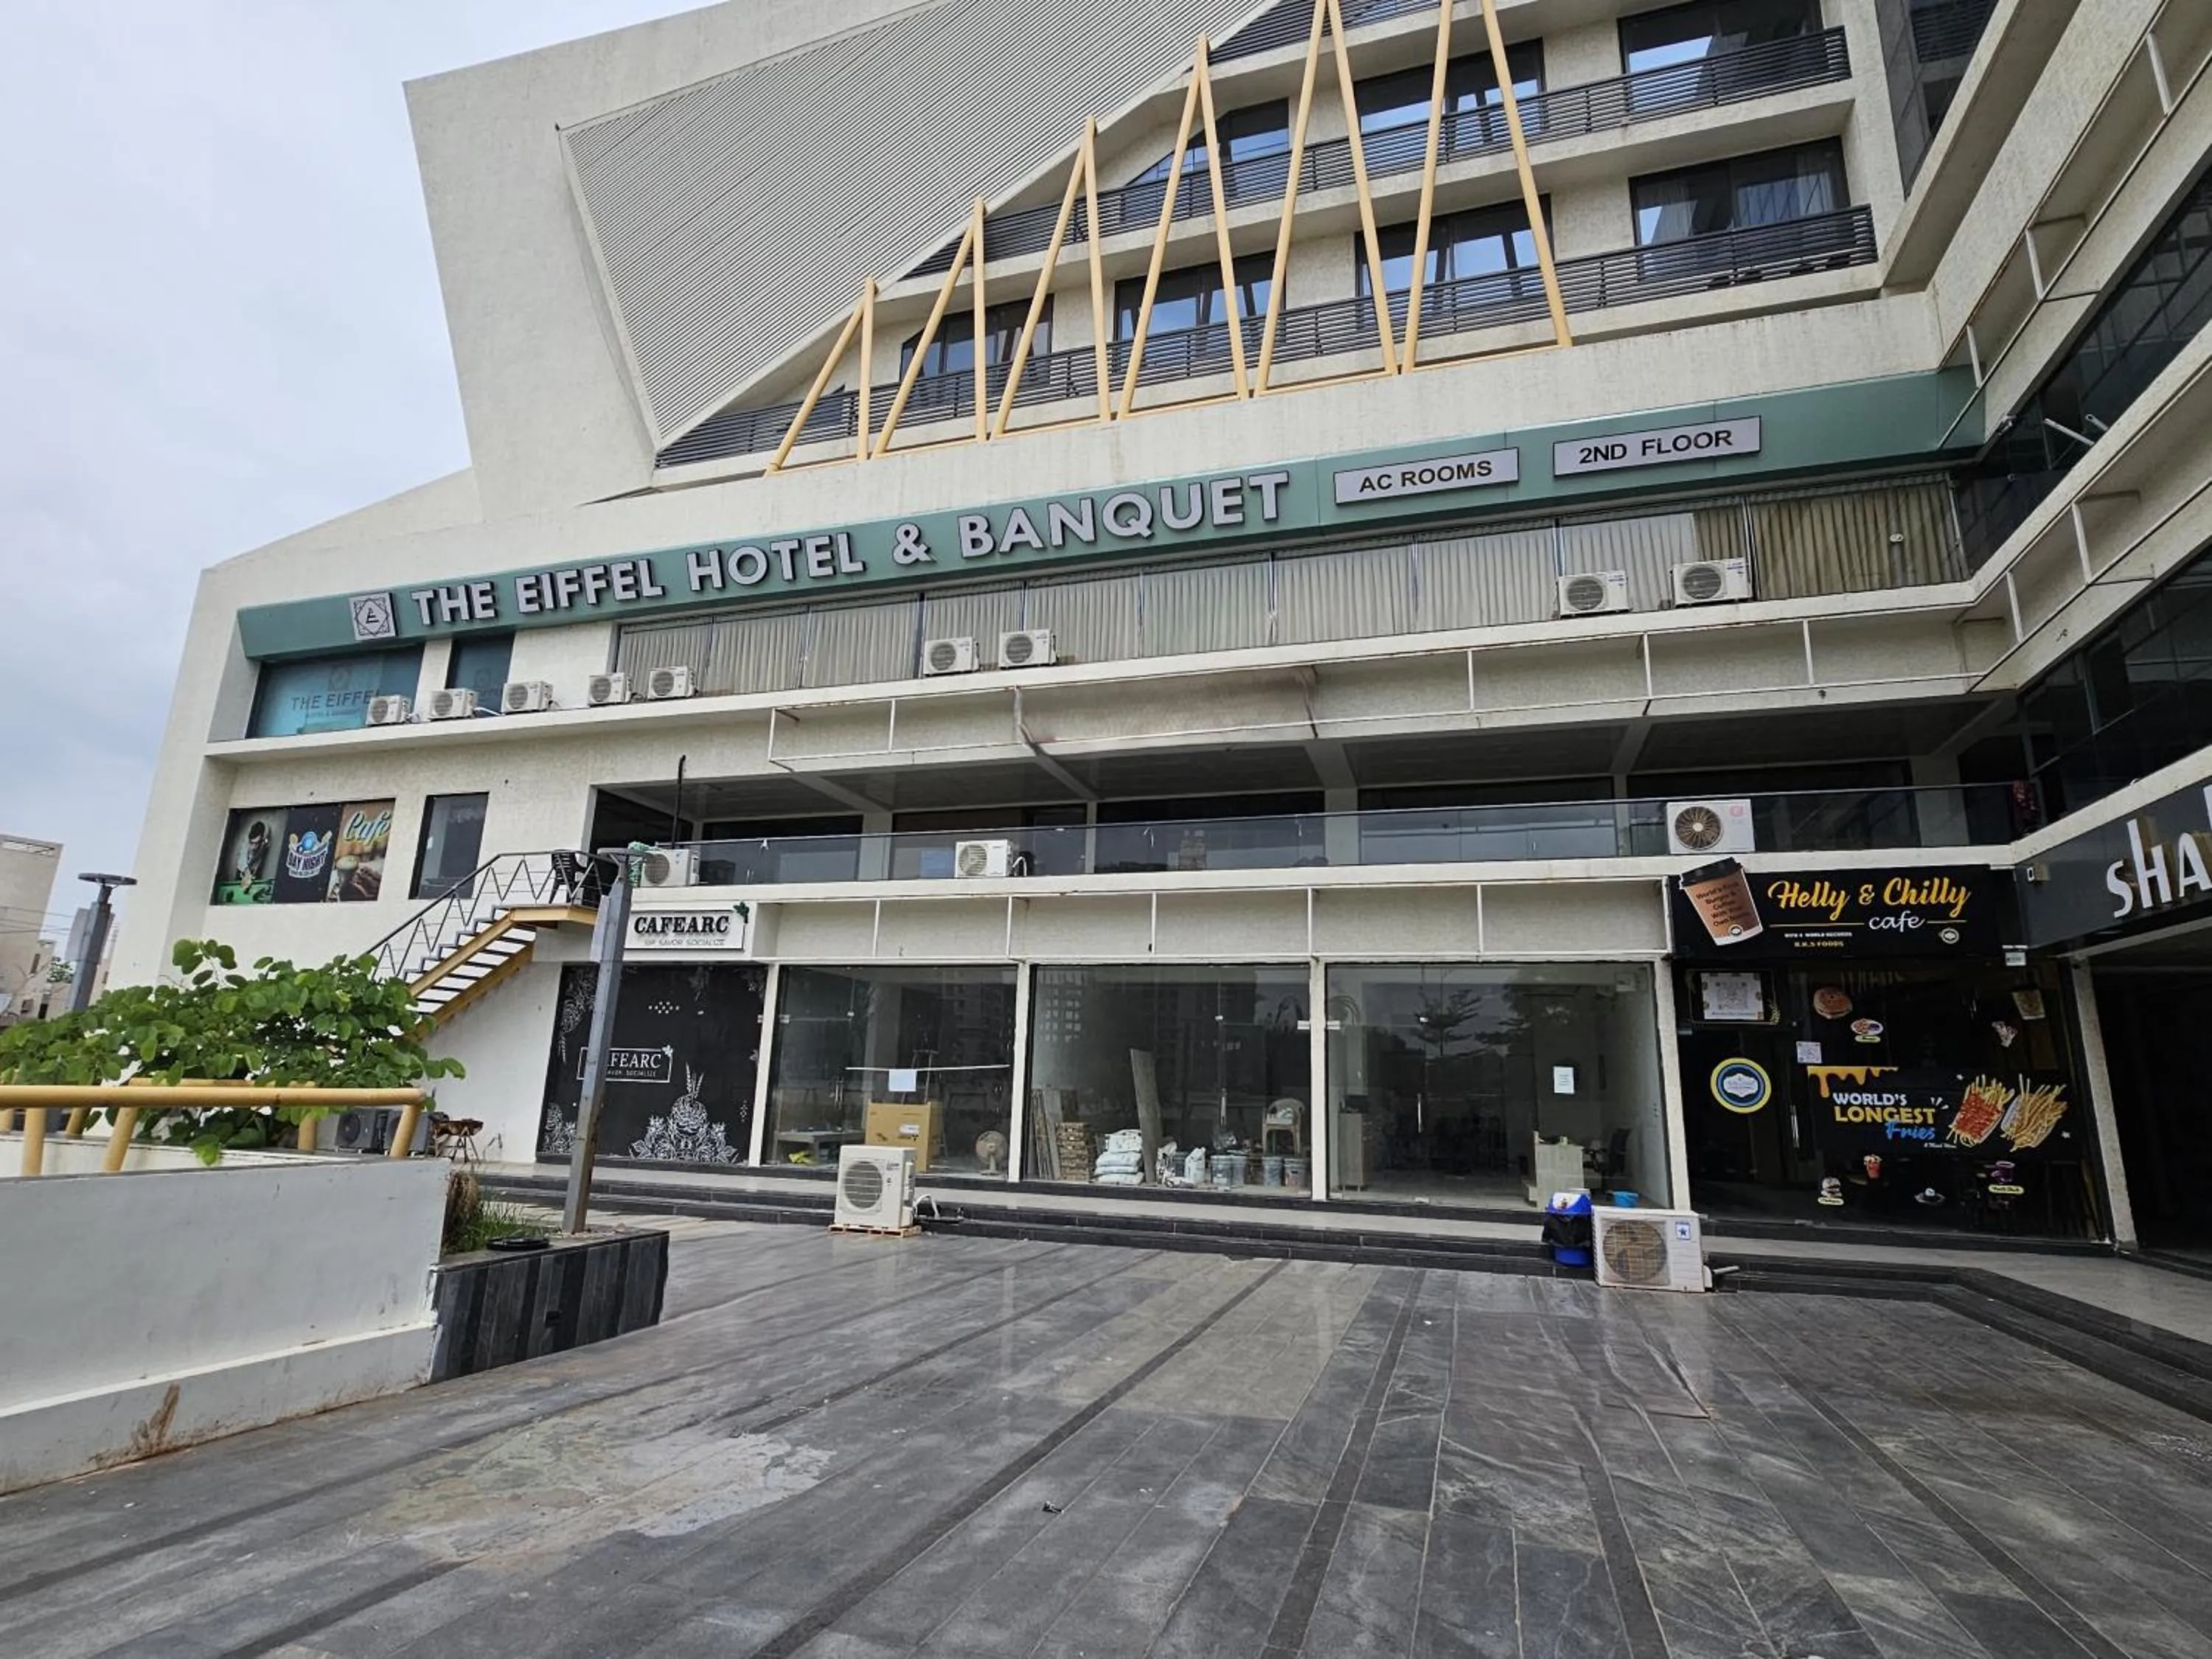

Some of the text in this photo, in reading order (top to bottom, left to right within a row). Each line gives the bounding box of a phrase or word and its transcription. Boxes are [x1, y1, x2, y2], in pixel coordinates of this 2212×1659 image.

[1579, 429, 1733, 465] 2ND FLOOR
[1359, 460, 1492, 493] AC ROOMS
[411, 470, 1289, 626] THE EIFFEL HOTEL & BANQUET
[291, 695, 322, 710] THE
[2107, 784, 2212, 918] SHA
[1767, 877, 1971, 921] Helly & Chilly
[634, 915, 729, 934] CAFEARC
[1868, 911, 1925, 933] cafe
[607, 1052, 661, 1068] FEARC
[1832, 1092, 1907, 1105] WORLD'S
[1834, 1106, 1935, 1124] LONGEST
[1885, 1121, 1935, 1141] Fries
